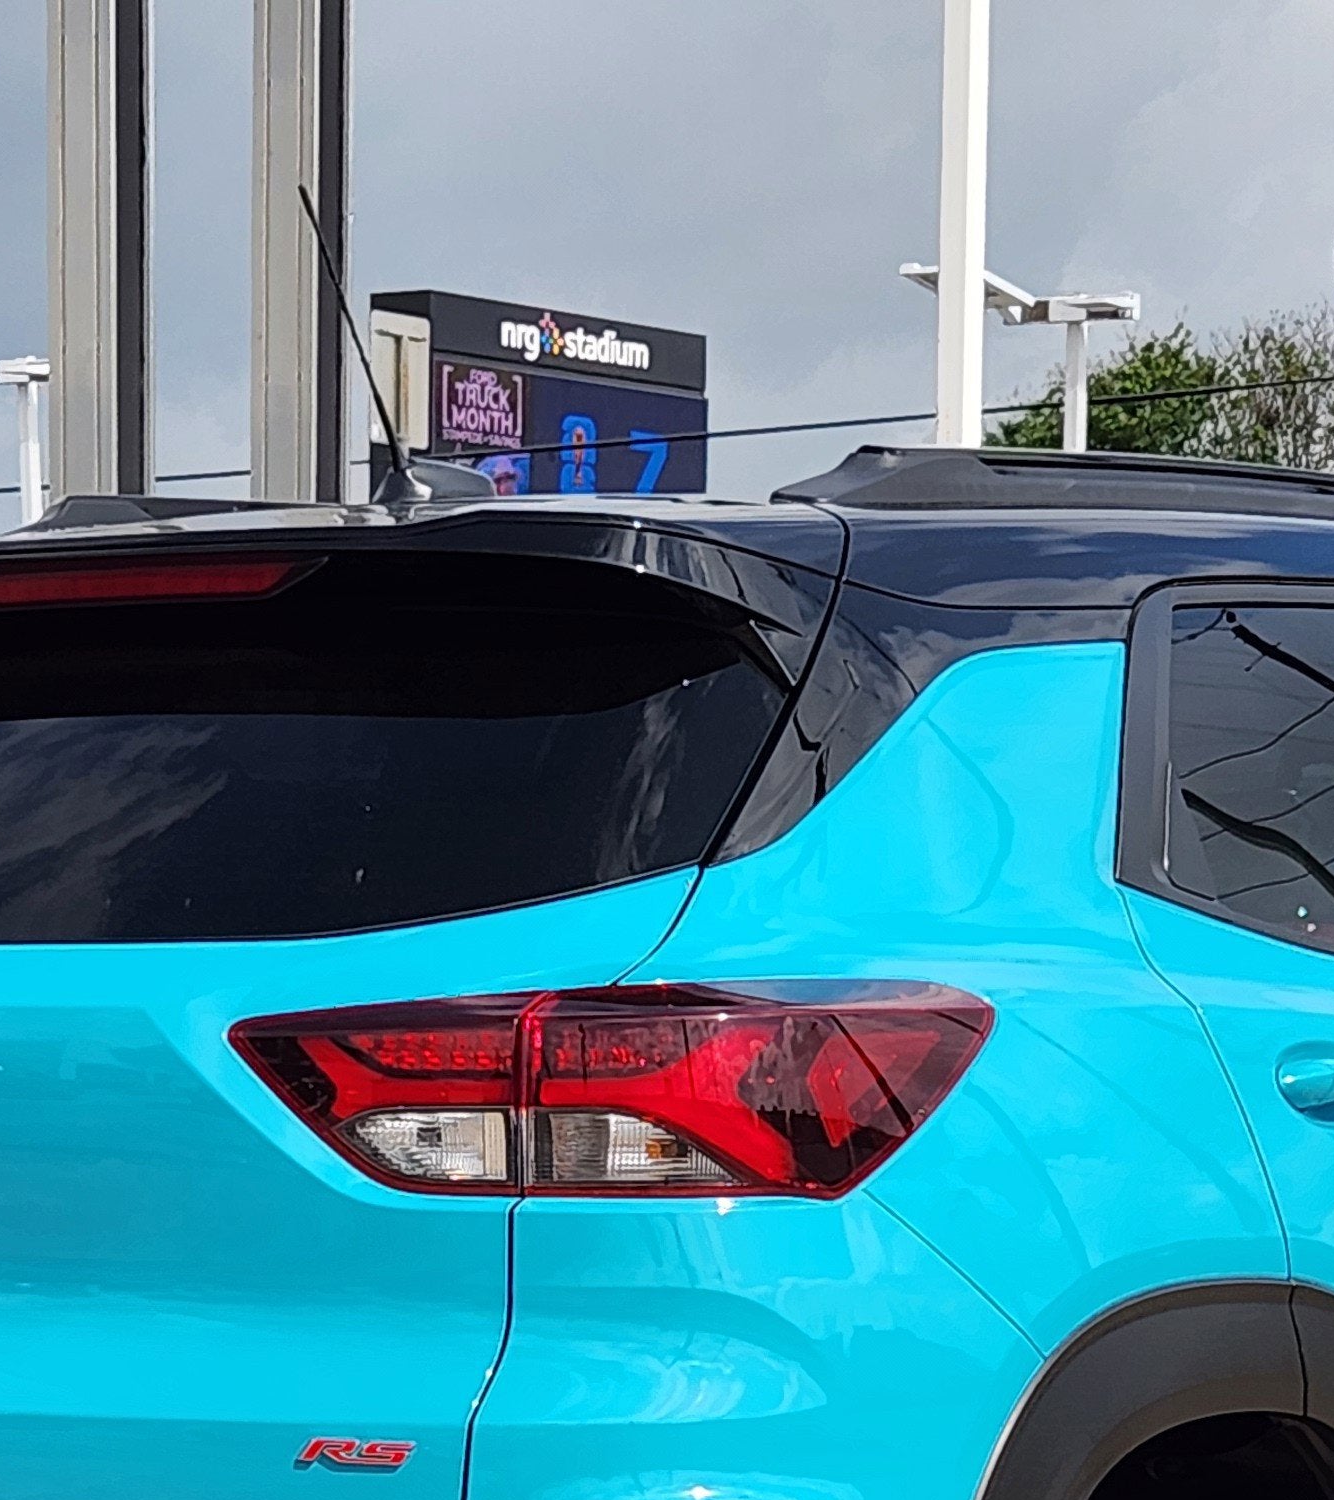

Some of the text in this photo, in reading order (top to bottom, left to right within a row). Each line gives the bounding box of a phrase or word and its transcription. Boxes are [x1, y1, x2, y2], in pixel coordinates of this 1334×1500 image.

[500, 319, 650, 370] nrg stadium
[454, 379, 511, 412] TRUCK
[451, 403, 514, 436] MONTH
[297, 1436, 417, 1467] RS
